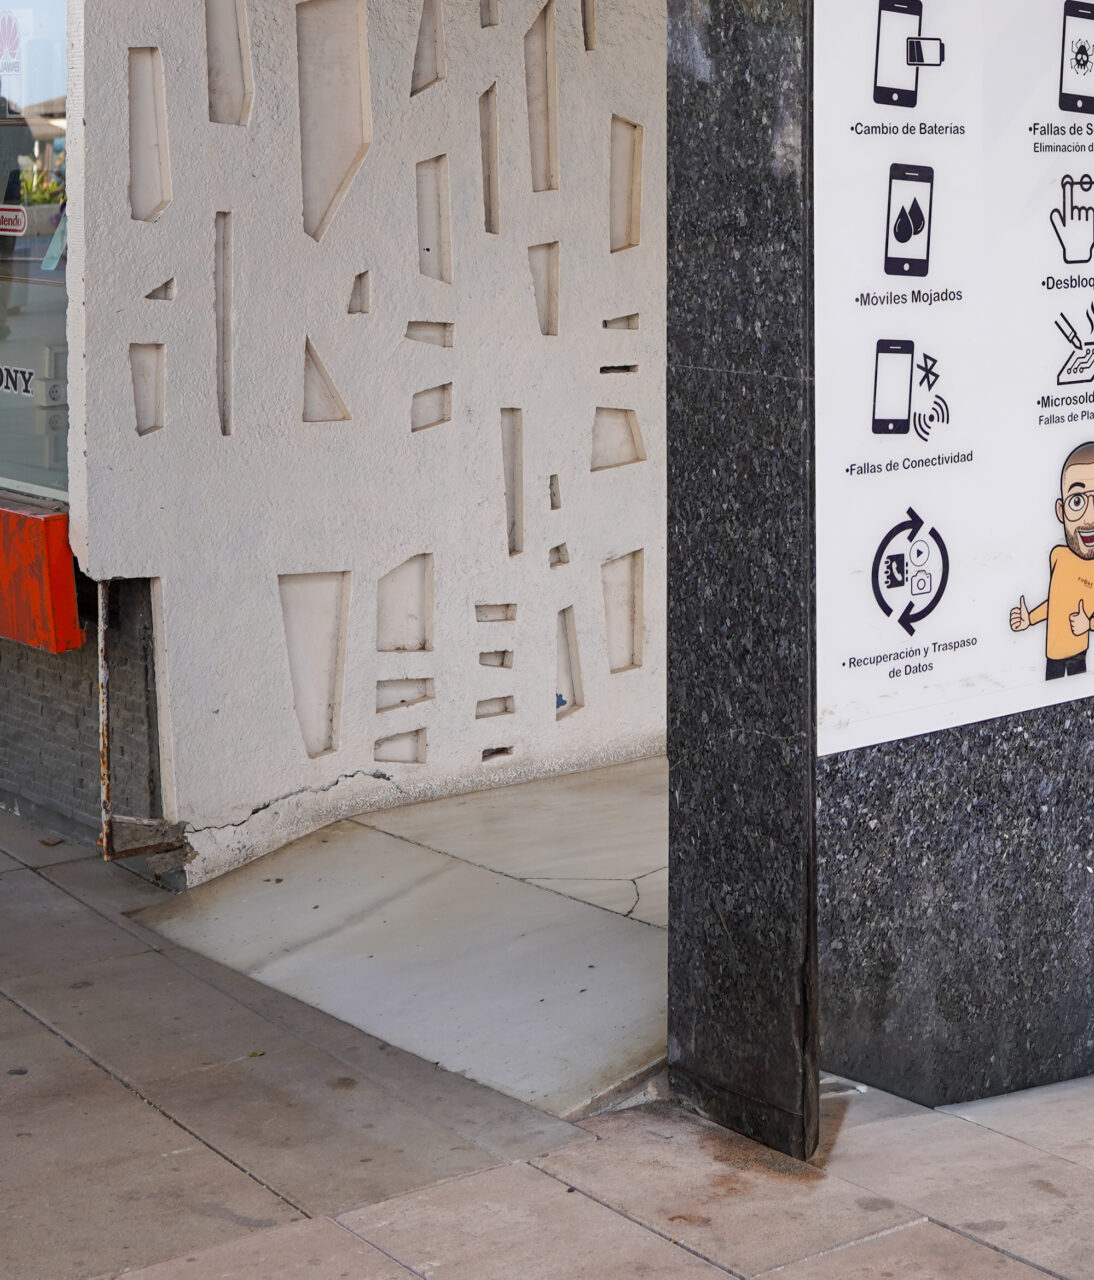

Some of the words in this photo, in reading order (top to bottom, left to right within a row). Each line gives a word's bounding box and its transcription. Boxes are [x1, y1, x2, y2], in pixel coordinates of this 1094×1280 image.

[901, 122, 916, 136] de
[919, 122, 965, 136] Baterías
[1069, 123, 1084, 136] de
[1033, 141, 1086, 154] Eliminación
[911, 288, 963, 306] Mojados
[1039, 414, 1066, 426] Fallas
[1067, 412, 1079, 423] de
[885, 459, 900, 473] de
[902, 450, 973, 471] Conectividad
[849, 645, 921, 669] Recuperación
[923, 646, 930, 659] y
[932, 636, 977, 654] Traspaso
[888, 666, 902, 679] de
[904, 662, 934, 677] Datos
